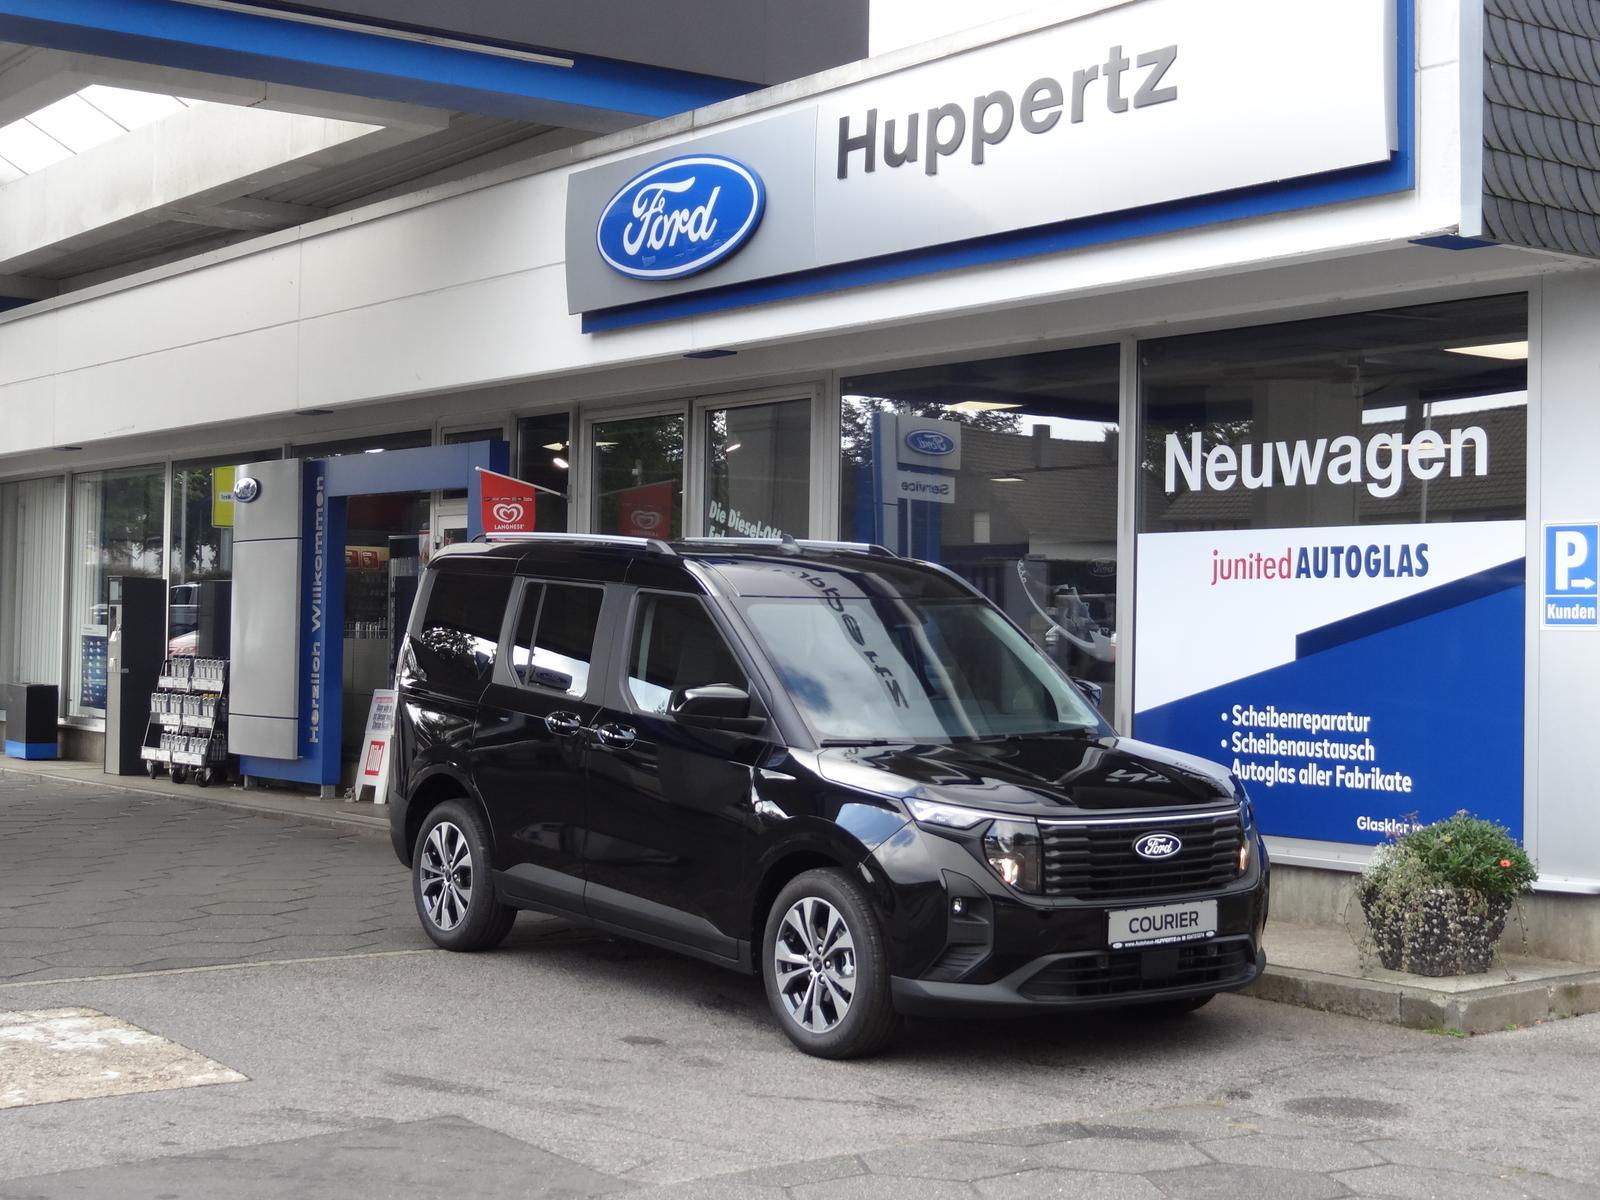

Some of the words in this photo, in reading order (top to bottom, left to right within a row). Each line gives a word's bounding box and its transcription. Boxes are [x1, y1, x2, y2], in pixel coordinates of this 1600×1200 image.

[836, 44, 1178, 179] Huppertz
[1164, 426, 1488, 498] Neuwagen
[708, 500, 727, 524] Die
[311, 475, 325, 632] Willkommen
[1555, 530, 1588, 590] P
[1547, 603, 1596, 620] Kunden
[308, 641, 321, 743] Herzlich
[1231, 704, 1371, 735] Scheibenreparatur
[1231, 731, 1376, 762] Scheibenaustausch
[1231, 757, 1296, 788] Autoglas
[1298, 762, 1333, 787] aller
[1335, 765, 1413, 793] Fabrikate
[1128, 910, 1199, 934] COURIER
